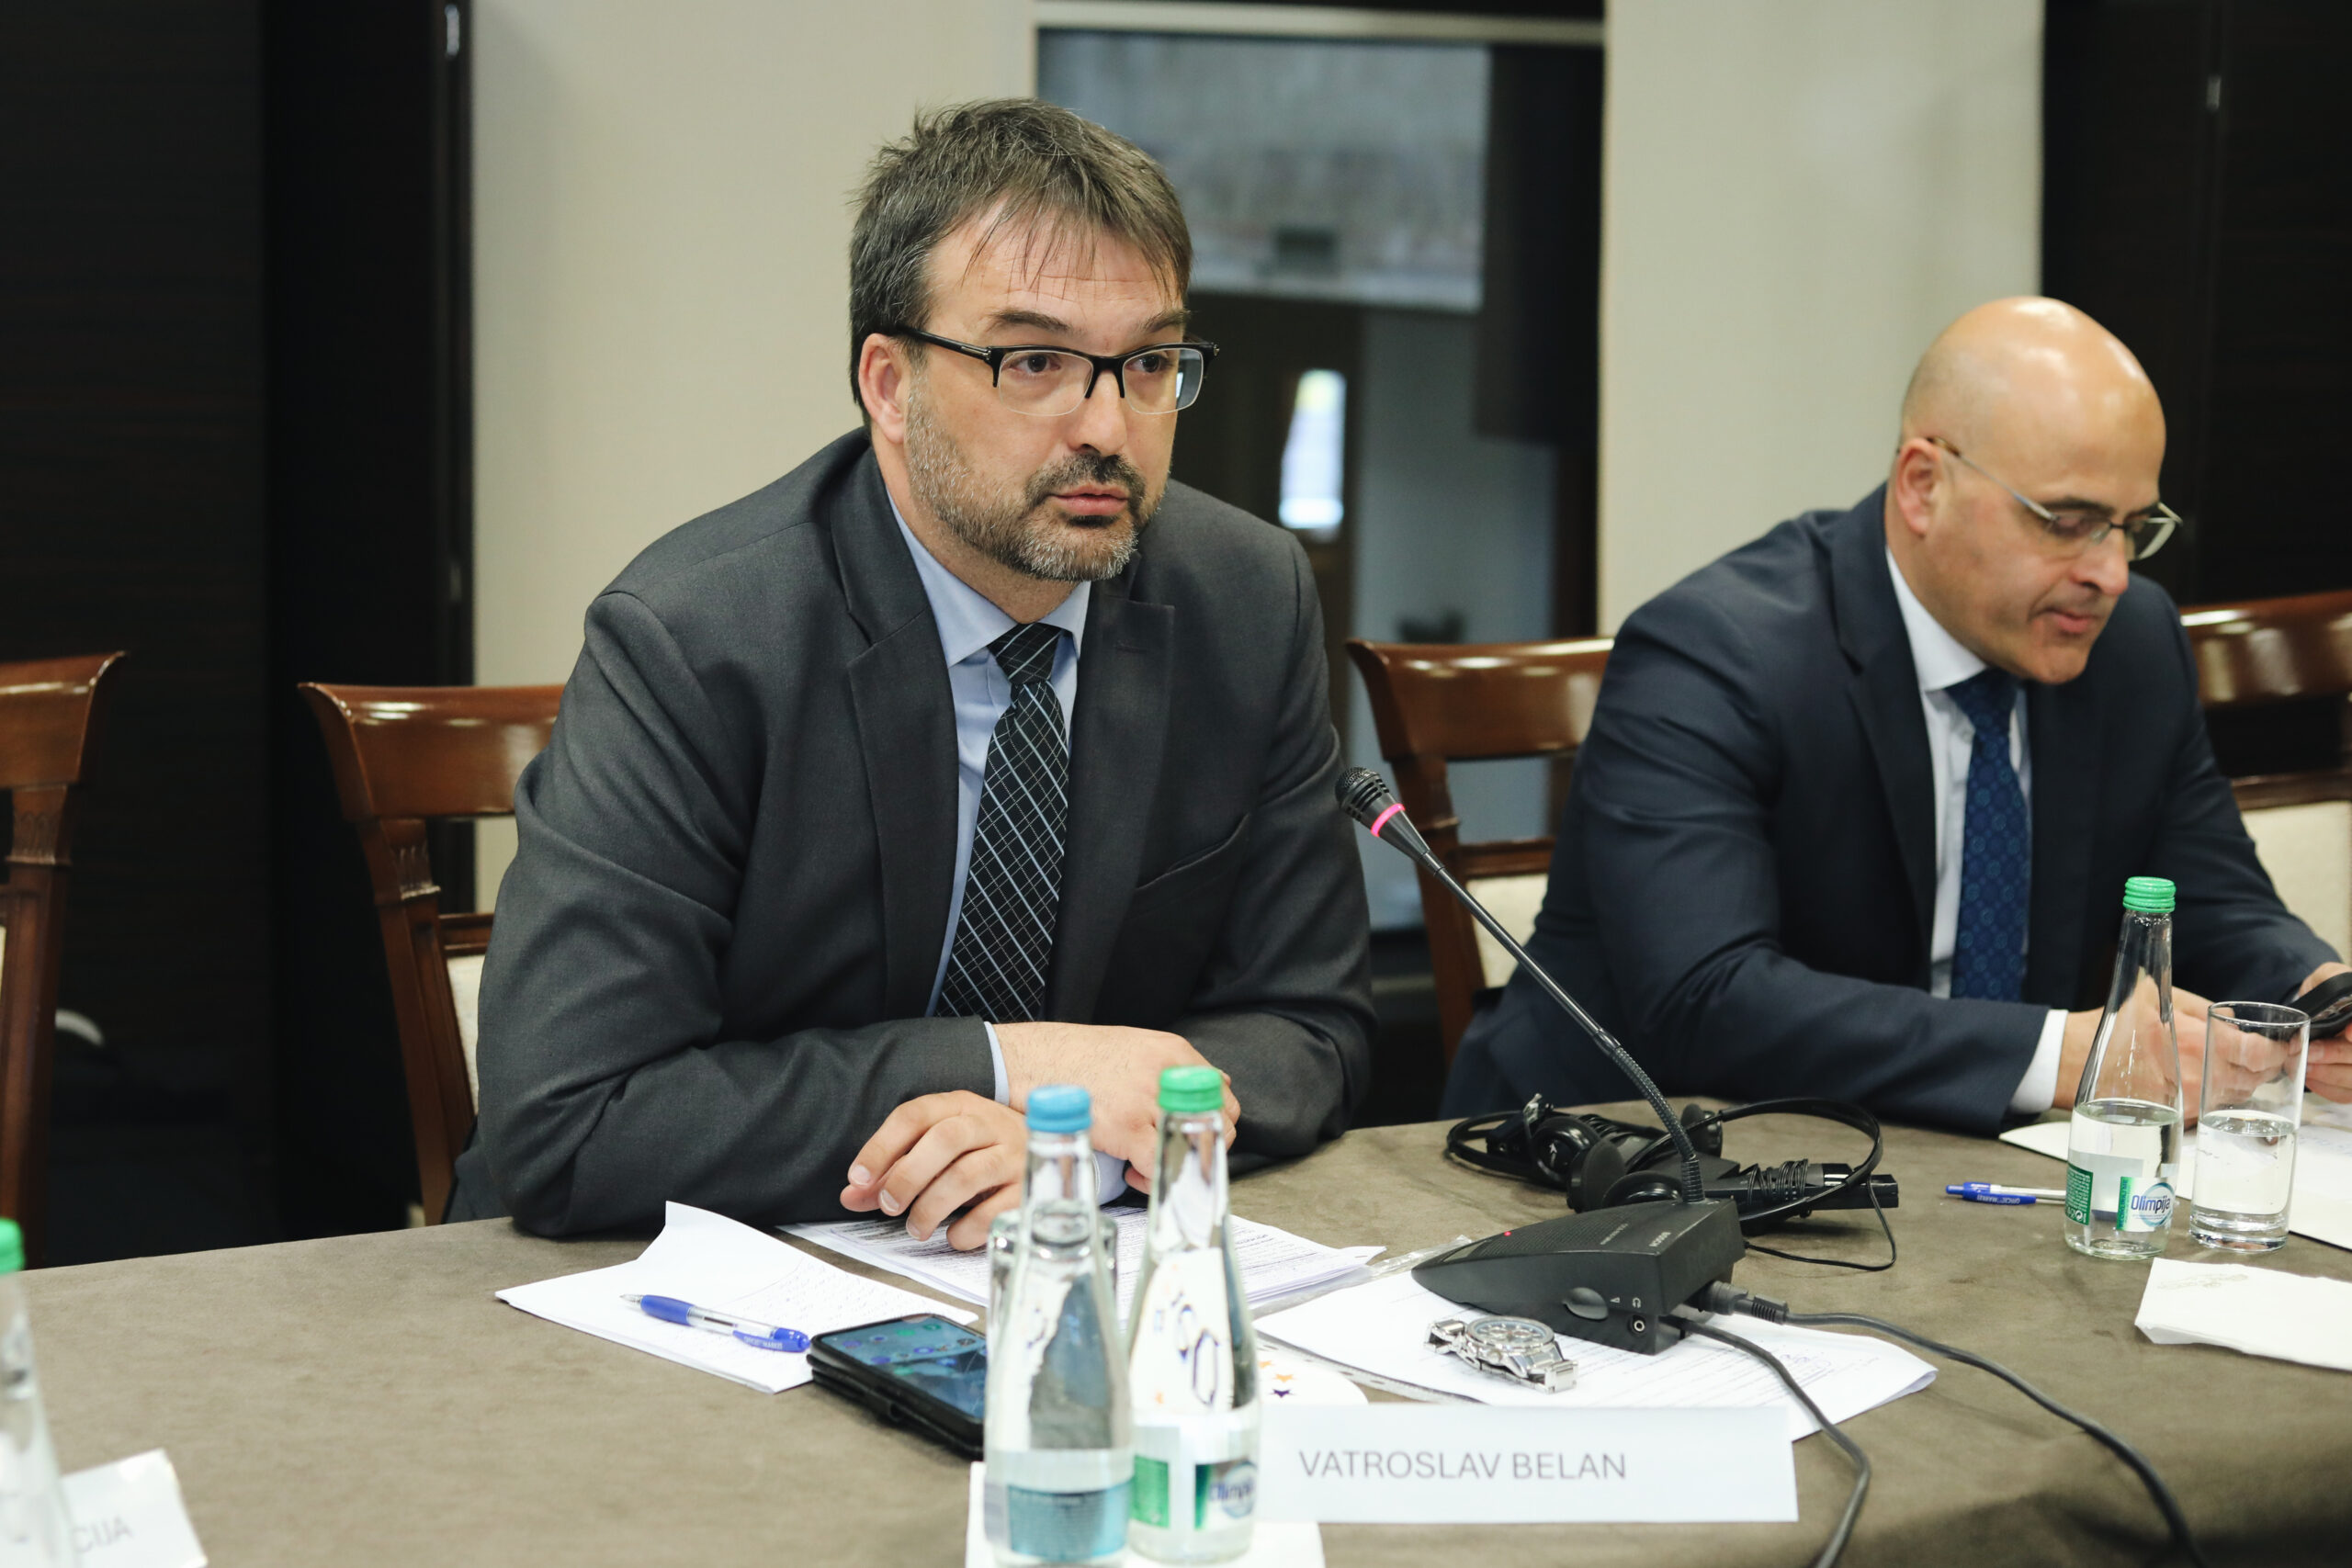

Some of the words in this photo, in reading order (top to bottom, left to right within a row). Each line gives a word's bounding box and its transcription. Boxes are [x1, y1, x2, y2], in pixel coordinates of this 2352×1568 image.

[2131, 1195, 2171, 1214] Olimpija
[1298, 1450, 1501, 1480] VATROSLAV
[1512, 1453, 1626, 1480] BELAN
